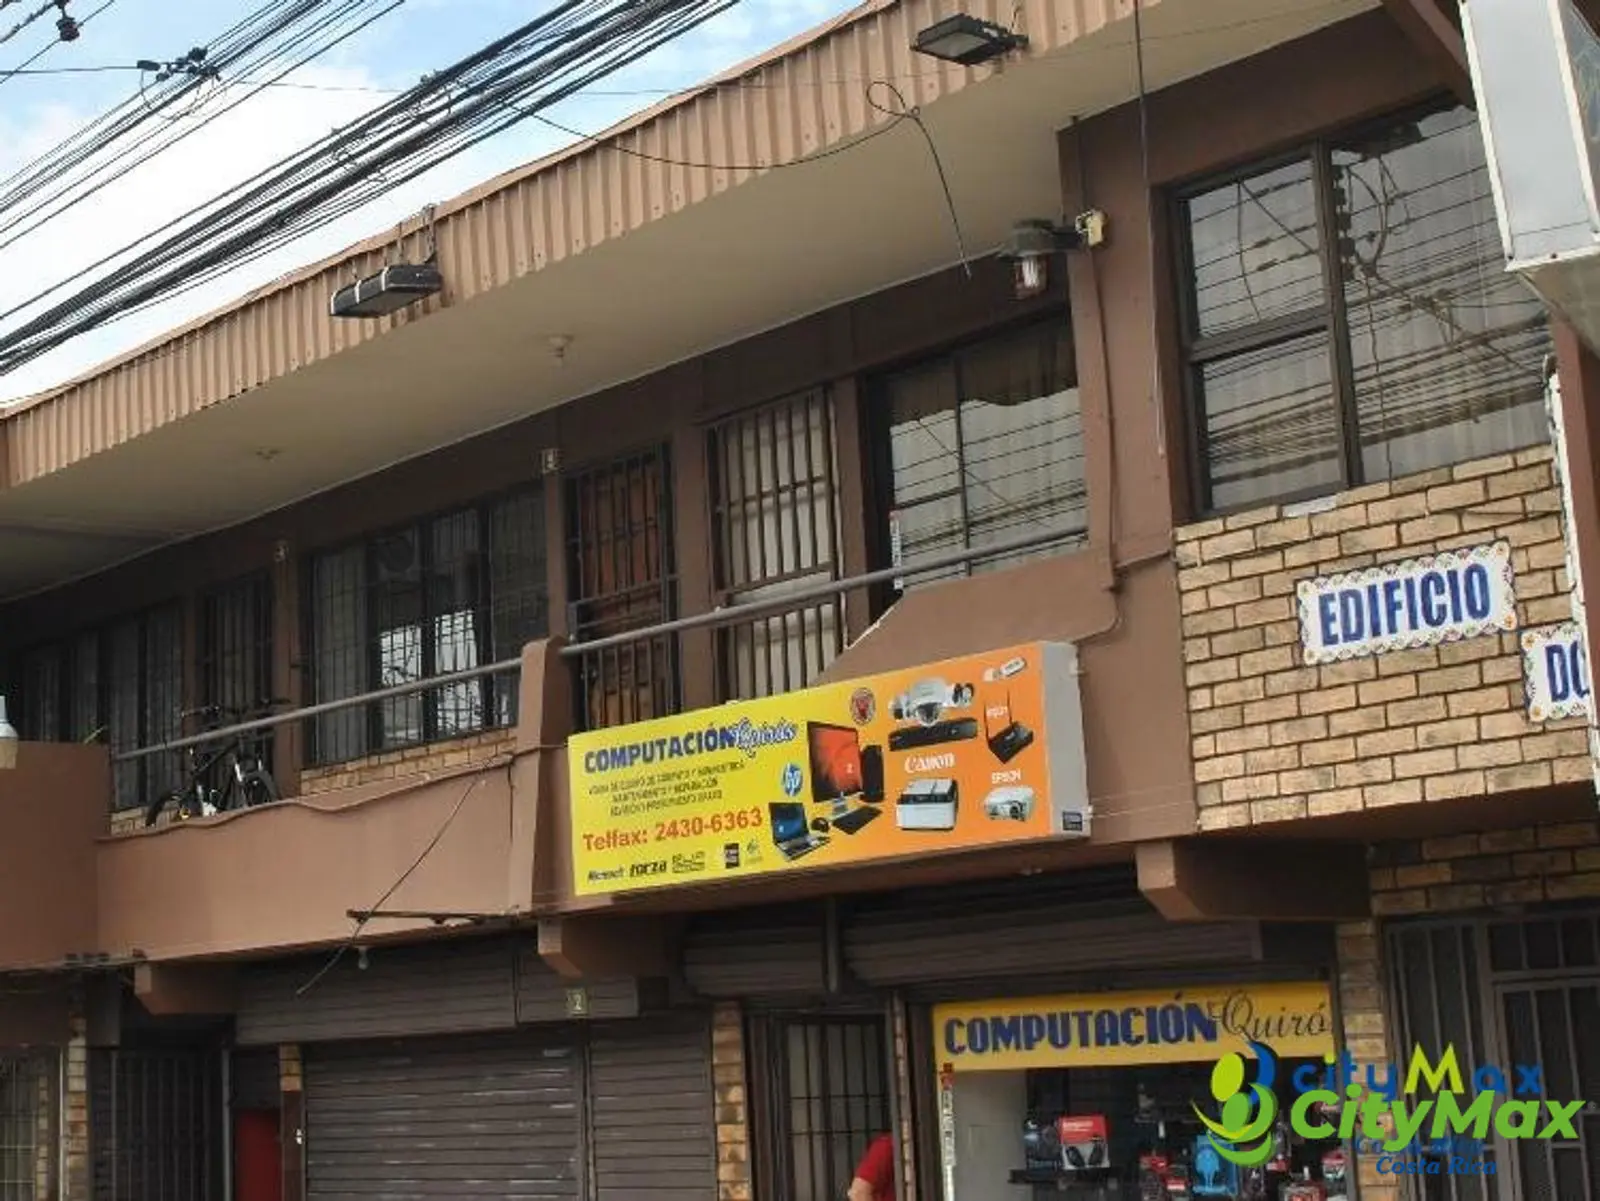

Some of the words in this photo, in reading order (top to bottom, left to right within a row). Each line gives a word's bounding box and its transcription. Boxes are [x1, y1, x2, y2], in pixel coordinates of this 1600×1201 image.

[1318, 562, 1490, 647] EDIFICIO
[584, 722, 737, 774] COMPUTACIÓN
[583, 829, 648, 851] Telfax:
[655, 807, 763, 842] 2430-6363
[944, 993, 1217, 1055] COMPUTACIÓN
